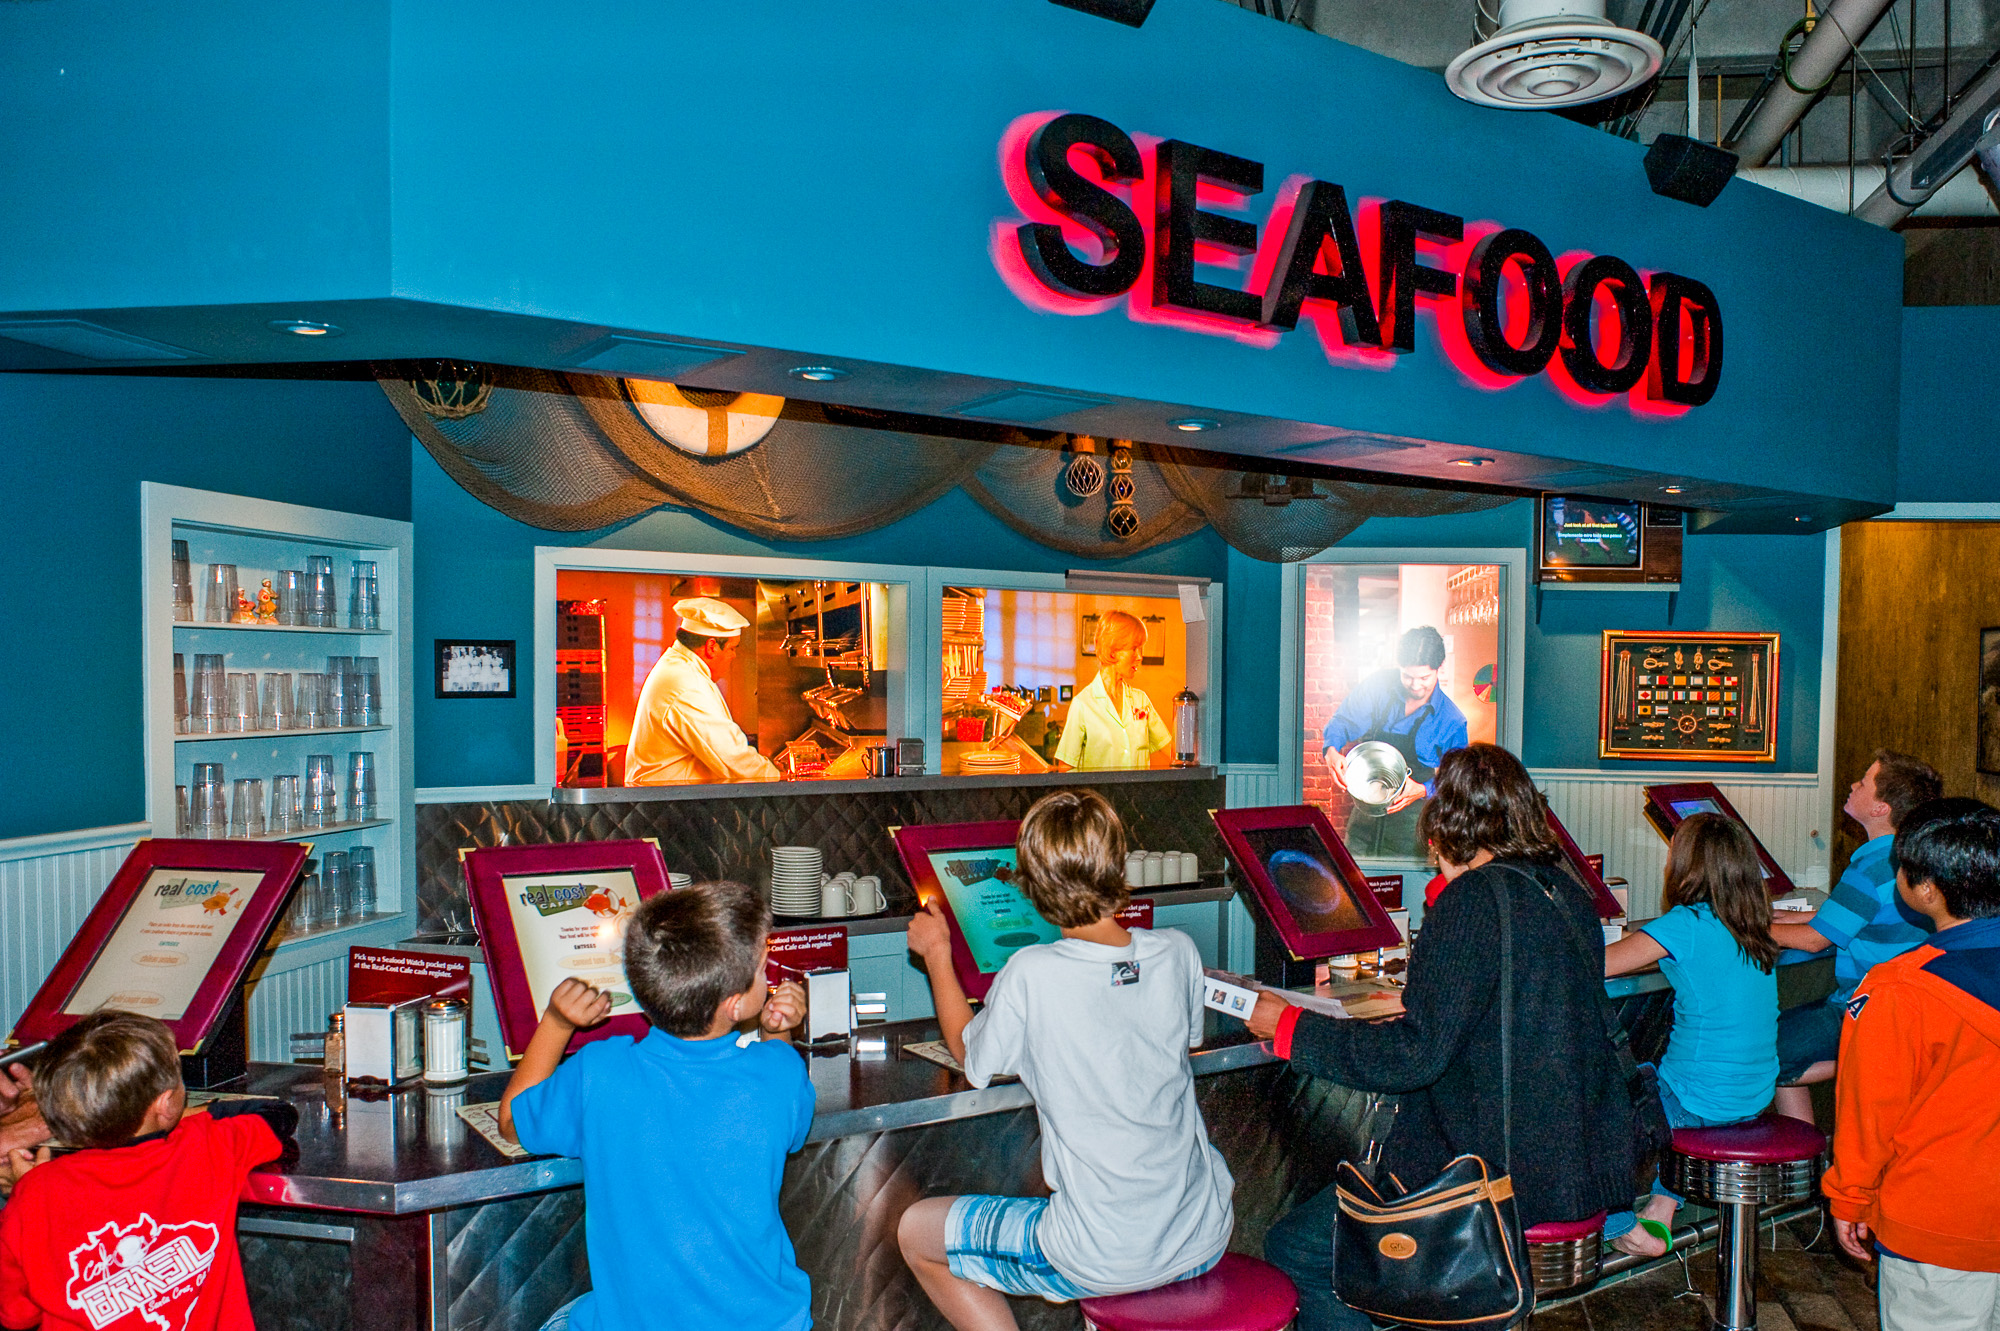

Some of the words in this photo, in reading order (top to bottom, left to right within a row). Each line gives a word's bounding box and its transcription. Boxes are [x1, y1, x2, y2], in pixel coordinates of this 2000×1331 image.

[1017, 112, 1723, 407] SEAFOOD
[154, 878, 188, 896] real
[186, 880, 219, 895] cost
[520, 884, 549, 906] real
[555, 883, 587, 900] cost
[541, 900, 572, 909] CAFE
[767, 936, 790, 944] Seafood
[809, 934, 827, 942] pocket
[828, 932, 843, 940] guide
[812, 941, 832, 949] register.
[372, 963, 399, 973] Real-Cost
[429, 970, 452, 978] register.
[382, 956, 406, 965] Seafood
[426, 961, 446, 969] pocket
[447, 963, 464, 971] guide
[148, 1296, 170, 1312] Santa
[173, 1285, 193, 1299] Cruz,
